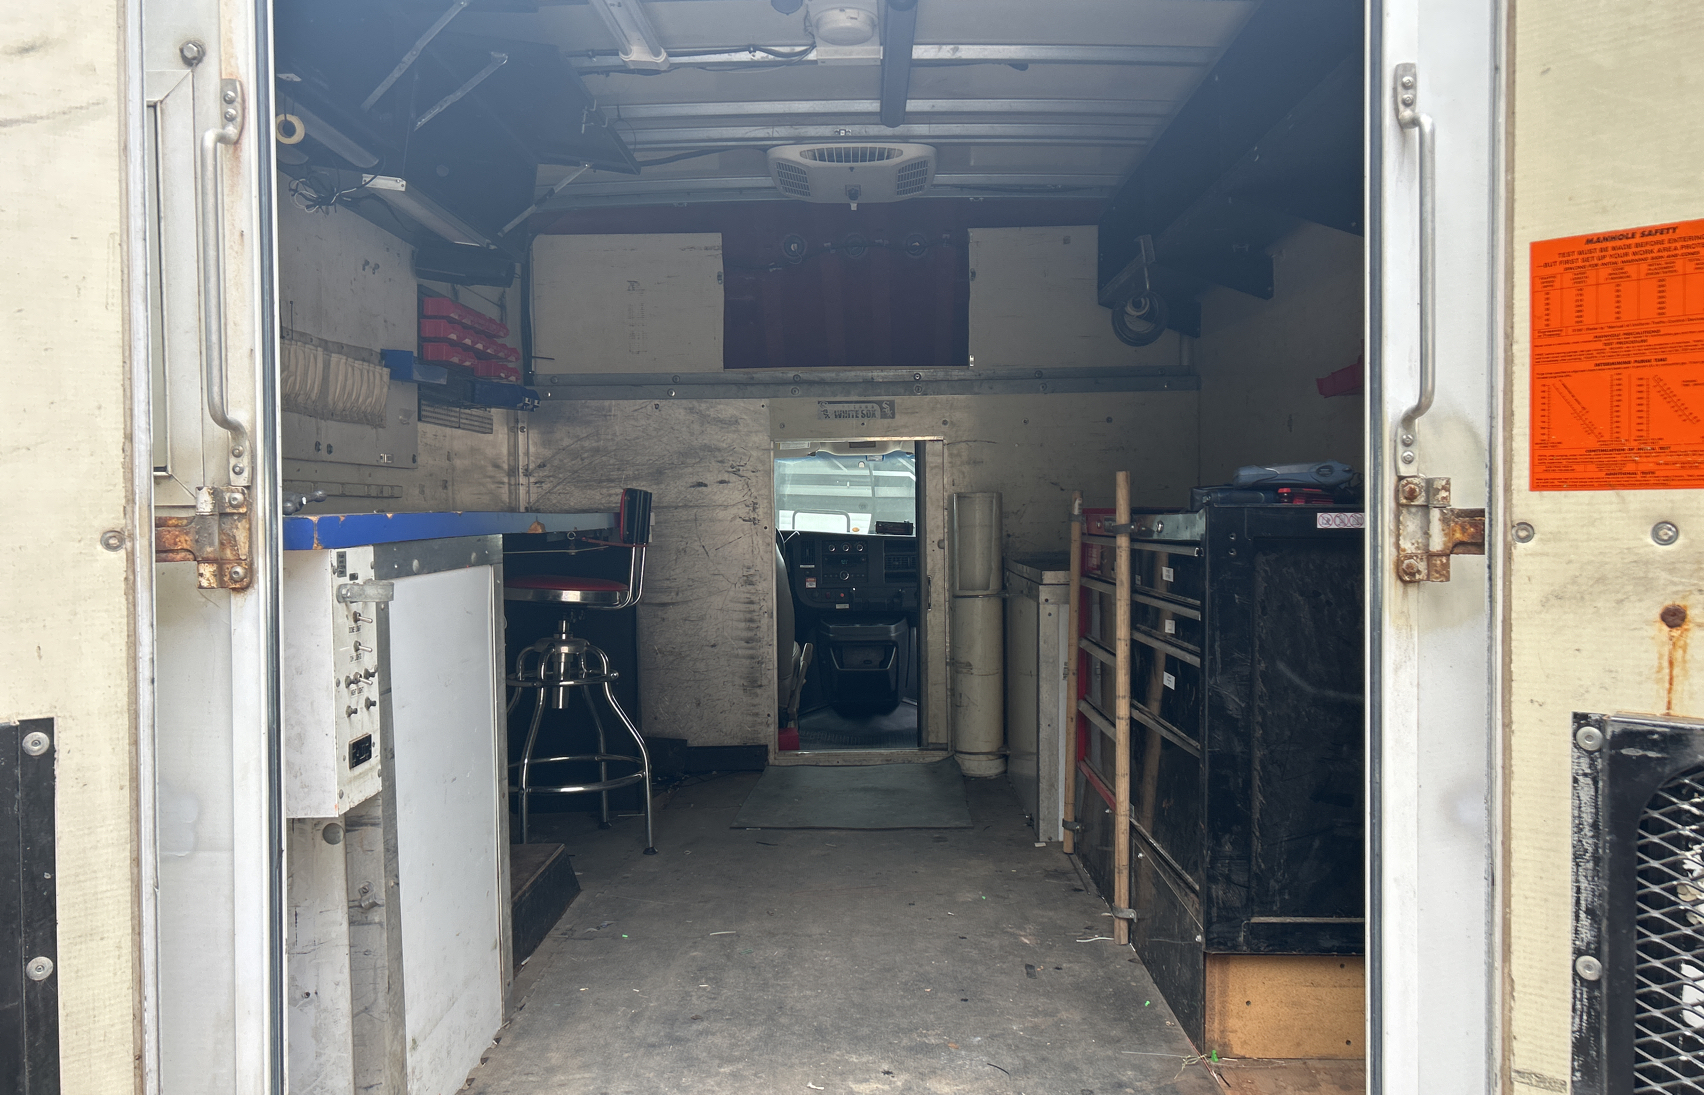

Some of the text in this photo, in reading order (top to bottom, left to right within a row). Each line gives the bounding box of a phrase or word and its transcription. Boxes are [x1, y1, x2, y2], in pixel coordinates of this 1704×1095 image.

[1585, 226, 1679, 245] MANHOLE SAFETY
[1558, 250, 1576, 259] TEST
[1611, 243, 1633, 252] MADE
[1634, 239, 1666, 249] BEFORE
[1559, 257, 1580, 266] FIRST
[1596, 254, 1608, 262] UP
[1632, 248, 1655, 257] WORK
[1657, 245, 1679, 254] AREA
[834, 409, 877, 419] WHITE SOX
